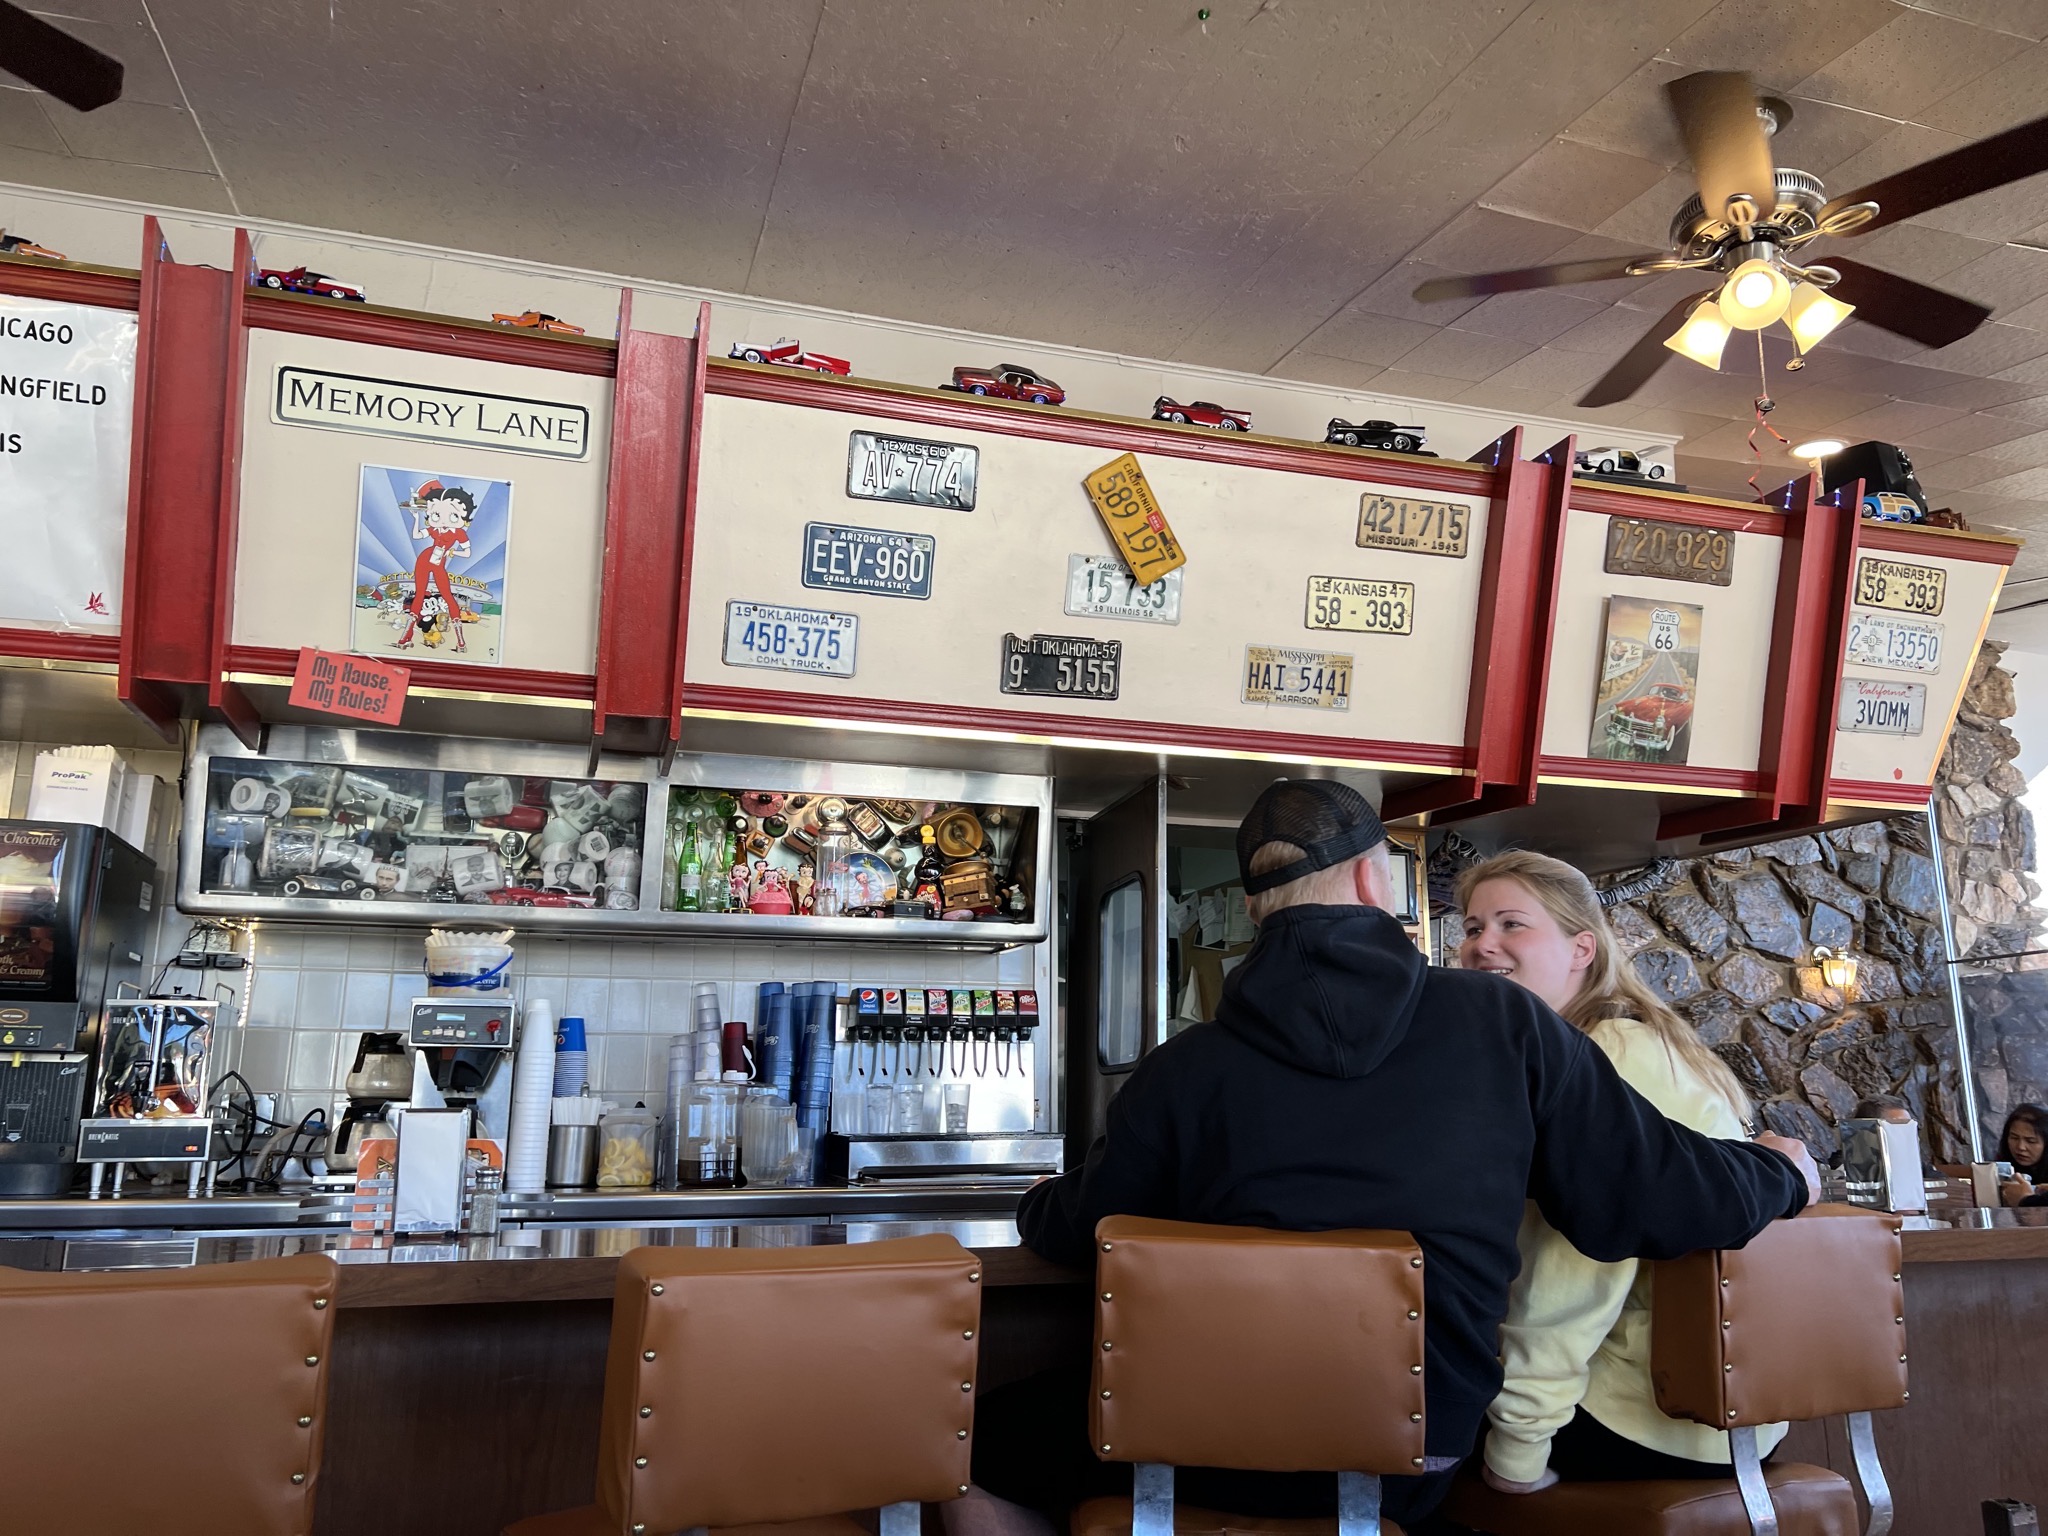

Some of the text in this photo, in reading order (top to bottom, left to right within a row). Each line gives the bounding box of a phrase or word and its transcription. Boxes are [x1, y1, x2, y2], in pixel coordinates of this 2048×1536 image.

[288, 377, 580, 444] MEMORY LANE
[881, 439, 948, 458] TEXAS 60
[862, 450, 962, 498] AV 774
[1097, 471, 1141, 520] 589
[1123, 463, 1153, 515] CALIFORNIA
[839, 531, 883, 545] ARIZONA
[888, 537, 903, 547] 64
[1123, 522, 1167, 569] 197
[1366, 534, 1418, 547] MISSOURI
[1431, 540, 1459, 552] 1945
[1614, 522, 1728, 571] 720-829
[812, 539, 925, 583] EEV-960
[1097, 563, 1117, 571] LAND
[823, 575, 912, 591] GRAND CANYON STATE
[1880, 564, 1926, 581] KANSAS
[1926, 570, 1941, 583] 47
[1087, 570, 1113, 603] 15
[1333, 582, 1387, 597] KANSAS
[1390, 584, 1407, 598] 47
[1864, 576, 1886, 602] 58
[1905, 582, 1939, 610] 393
[735, 606, 852, 628] 19 OKLAHOMA 79
[1094, 605, 1104, 613] 19
[1106, 606, 1141, 616] ILLINOIS
[1314, 595, 1341, 625] 58
[1365, 599, 1406, 629] 393
[1655, 612, 1677, 623] ROUTE
[1857, 617, 1868, 625] THE
[1870, 619, 1884, 628] LAND
[742, 620, 841, 660] 458-375
[1010, 639, 1038, 654] VISIT
[1654, 633, 1673, 650] 66
[1849, 625, 1861, 652] 2
[1887, 629, 1939, 662] 13550
[756, 655, 824, 669] COM'L TRUCK
[1277, 650, 1325, 665] MISSISSIPPI
[1866, 655, 1920, 669] NEW MEXICO
[311, 656, 337, 685] My
[1056, 657, 1116, 694] 5155
[1248, 662, 1286, 691] HAI
[1300, 667, 1348, 697] 5441
[308, 680, 389, 715] My Rules!
[1275, 694, 1319, 705] HARRISON
[1859, 683, 1911, 699] California
[51, 771, 87, 779] ProPak
[3, 831, 61, 847] Chocolate
